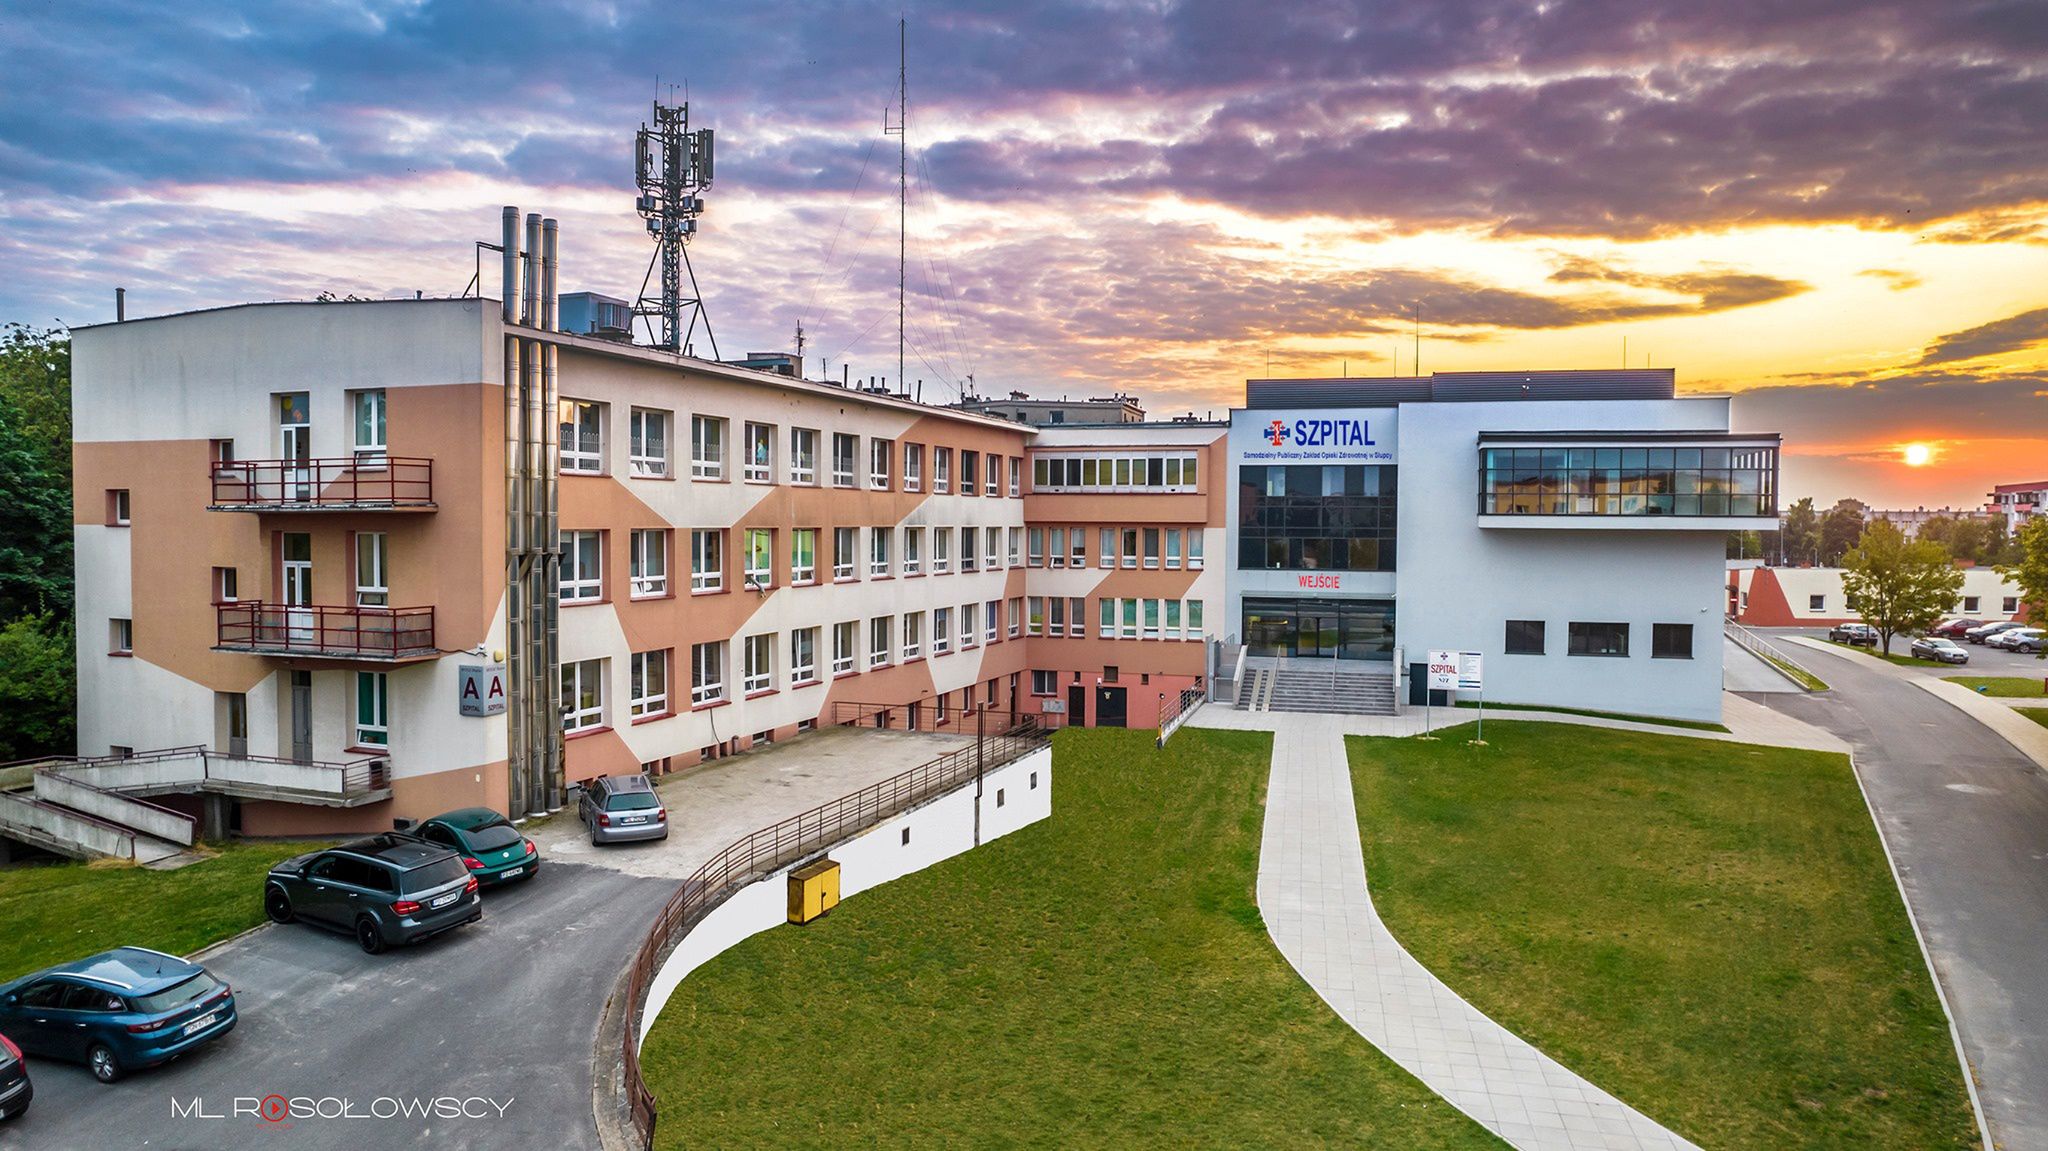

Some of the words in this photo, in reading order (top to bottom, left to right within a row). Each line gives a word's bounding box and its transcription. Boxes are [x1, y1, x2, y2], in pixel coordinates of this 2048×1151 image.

[1295, 420, 1375, 446] SZPITAL
[1243, 452, 1276, 460] Samodzielny
[1277, 452, 1302, 460] Publiczny
[1298, 573, 1340, 588] WEJŚCIE
[1430, 664, 1457, 674] SZPITAL
[463, 676, 480, 699] A
[488, 675, 504, 699] A
